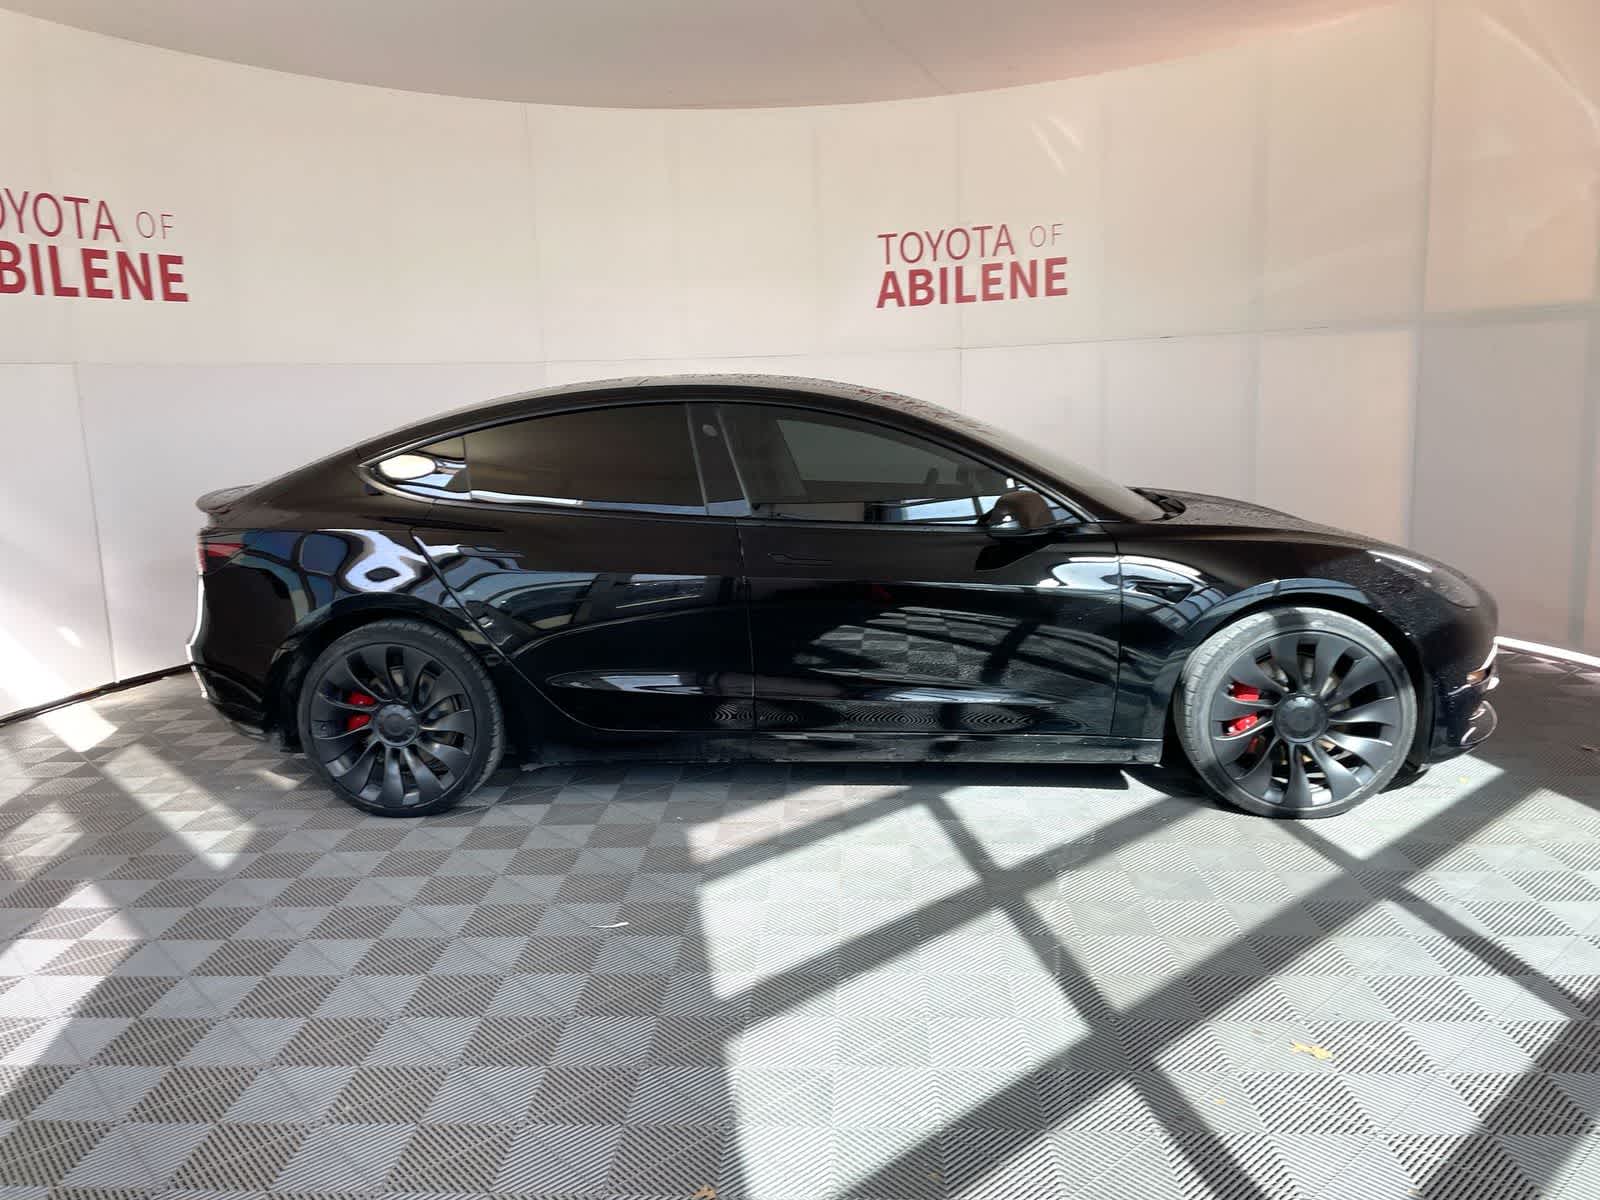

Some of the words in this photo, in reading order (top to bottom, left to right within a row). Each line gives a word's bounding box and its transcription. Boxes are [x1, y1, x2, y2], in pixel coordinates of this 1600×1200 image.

[0, 188, 121, 242] YOTA
[136, 211, 174, 239] OF
[877, 224, 1015, 265] TOYOTA
[1029, 223, 1063, 248] OF
[0, 240, 189, 302] BILENE
[876, 257, 1068, 308] ABILENE
